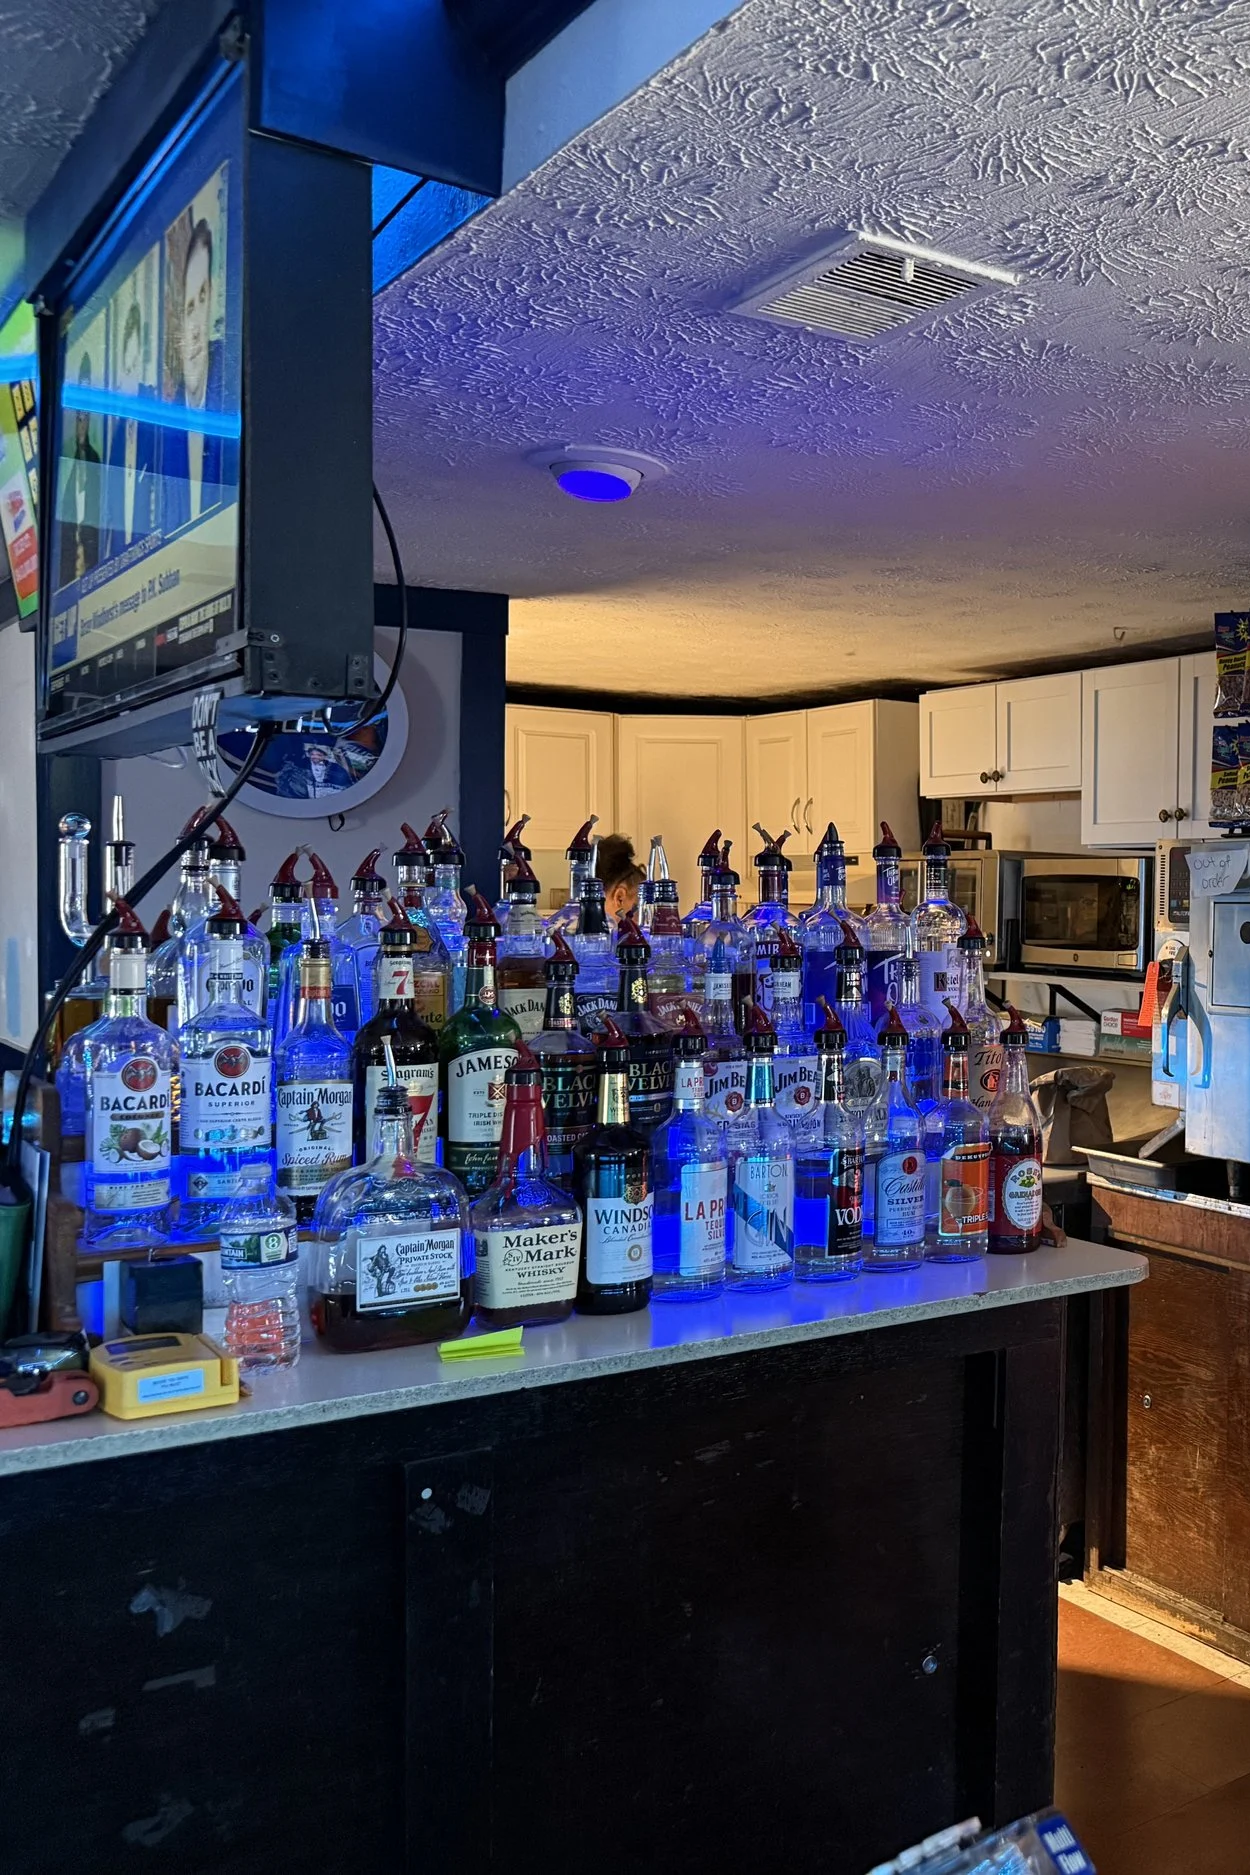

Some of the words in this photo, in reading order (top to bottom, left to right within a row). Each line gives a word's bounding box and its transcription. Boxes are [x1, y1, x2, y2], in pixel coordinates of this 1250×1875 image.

[1202, 872, 1230, 889] order
[391, 970, 410, 996] 7
[576, 1001, 598, 1017] JACK
[195, 1076, 266, 1097] BACARDÍ
[544, 1076, 596, 1091] BLAC
[681, 1078, 693, 1088] LA
[704, 1075, 729, 1099] JIM
[774, 1072, 797, 1093] JIM
[100, 1089, 170, 1112] BACARDÍ
[207, 1100, 255, 1108] SUPERIOR
[277, 1088, 314, 1109] Captain
[468, 1111, 492, 1119] TRIPLE
[282, 1153, 320, 1166] Spiced
[321, 1152, 348, 1166] Rum
[750, 1163, 788, 1180] BARTON
[684, 1200, 706, 1221] LA
[835, 1205, 863, 1226] VOD
[962, 1212, 985, 1224] TRIPLE
[744, 1206, 787, 1248] GIN
[396, 1243, 425, 1257] Captain
[425, 1238, 455, 1254] Morgan
[502, 1229, 578, 1249] Maker's
[400, 1254, 430, 1265] PRIVATE
[431, 1252, 453, 1260] STOCK
[523, 1245, 577, 1264] Mark
[516, 1267, 566, 1279] WHISKY
